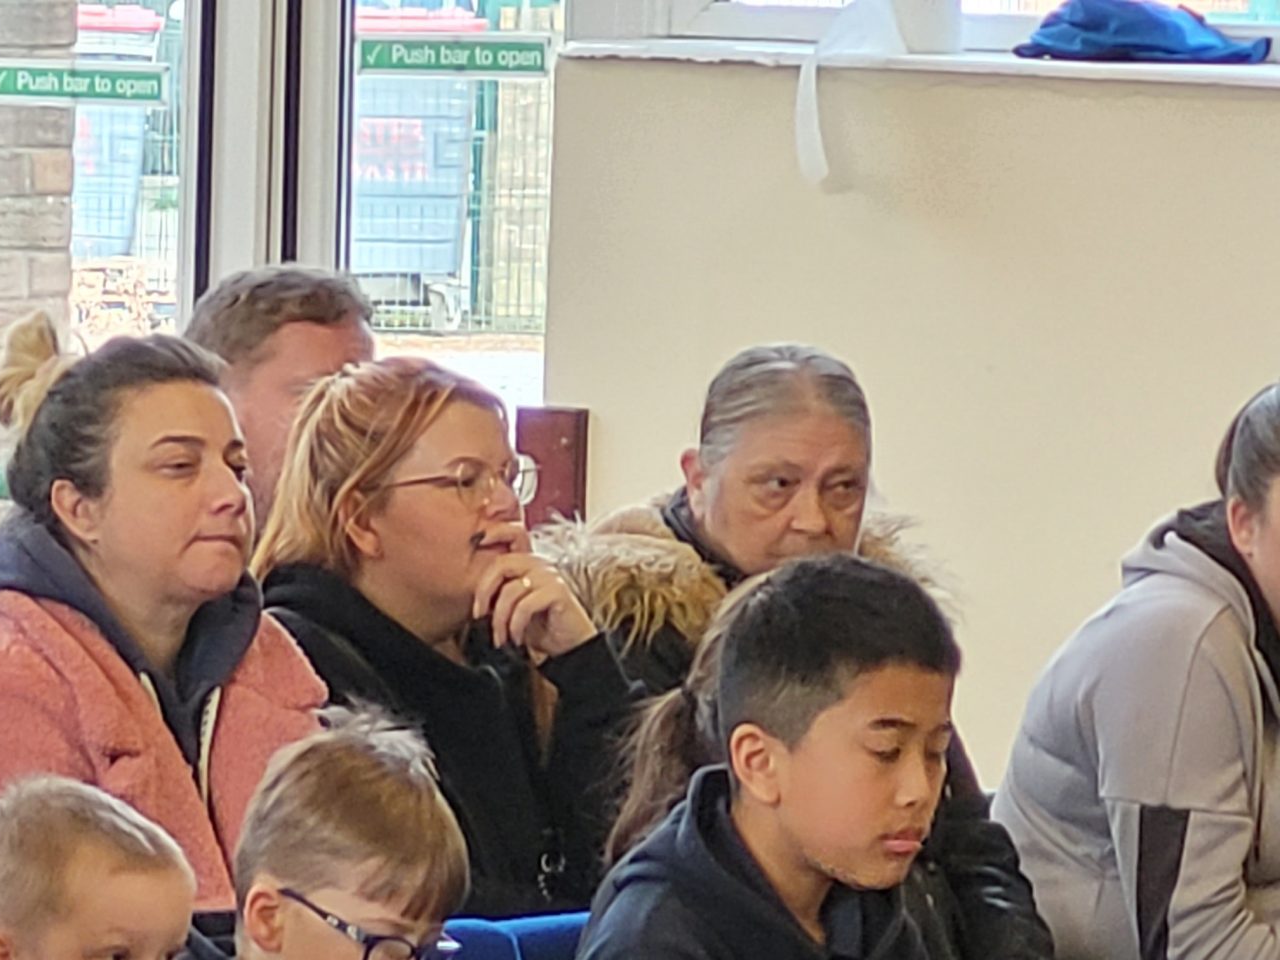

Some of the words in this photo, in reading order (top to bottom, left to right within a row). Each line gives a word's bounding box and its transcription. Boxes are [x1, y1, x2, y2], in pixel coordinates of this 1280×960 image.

[391, 44, 436, 65] Push
[439, 45, 471, 66] bar
[474, 46, 495, 66] to
[497, 50, 542, 69] open
[16, 70, 59, 91] Push
[62, 71, 91, 93] bar
[94, 74, 112, 93] to
[115, 78, 158, 97] open
